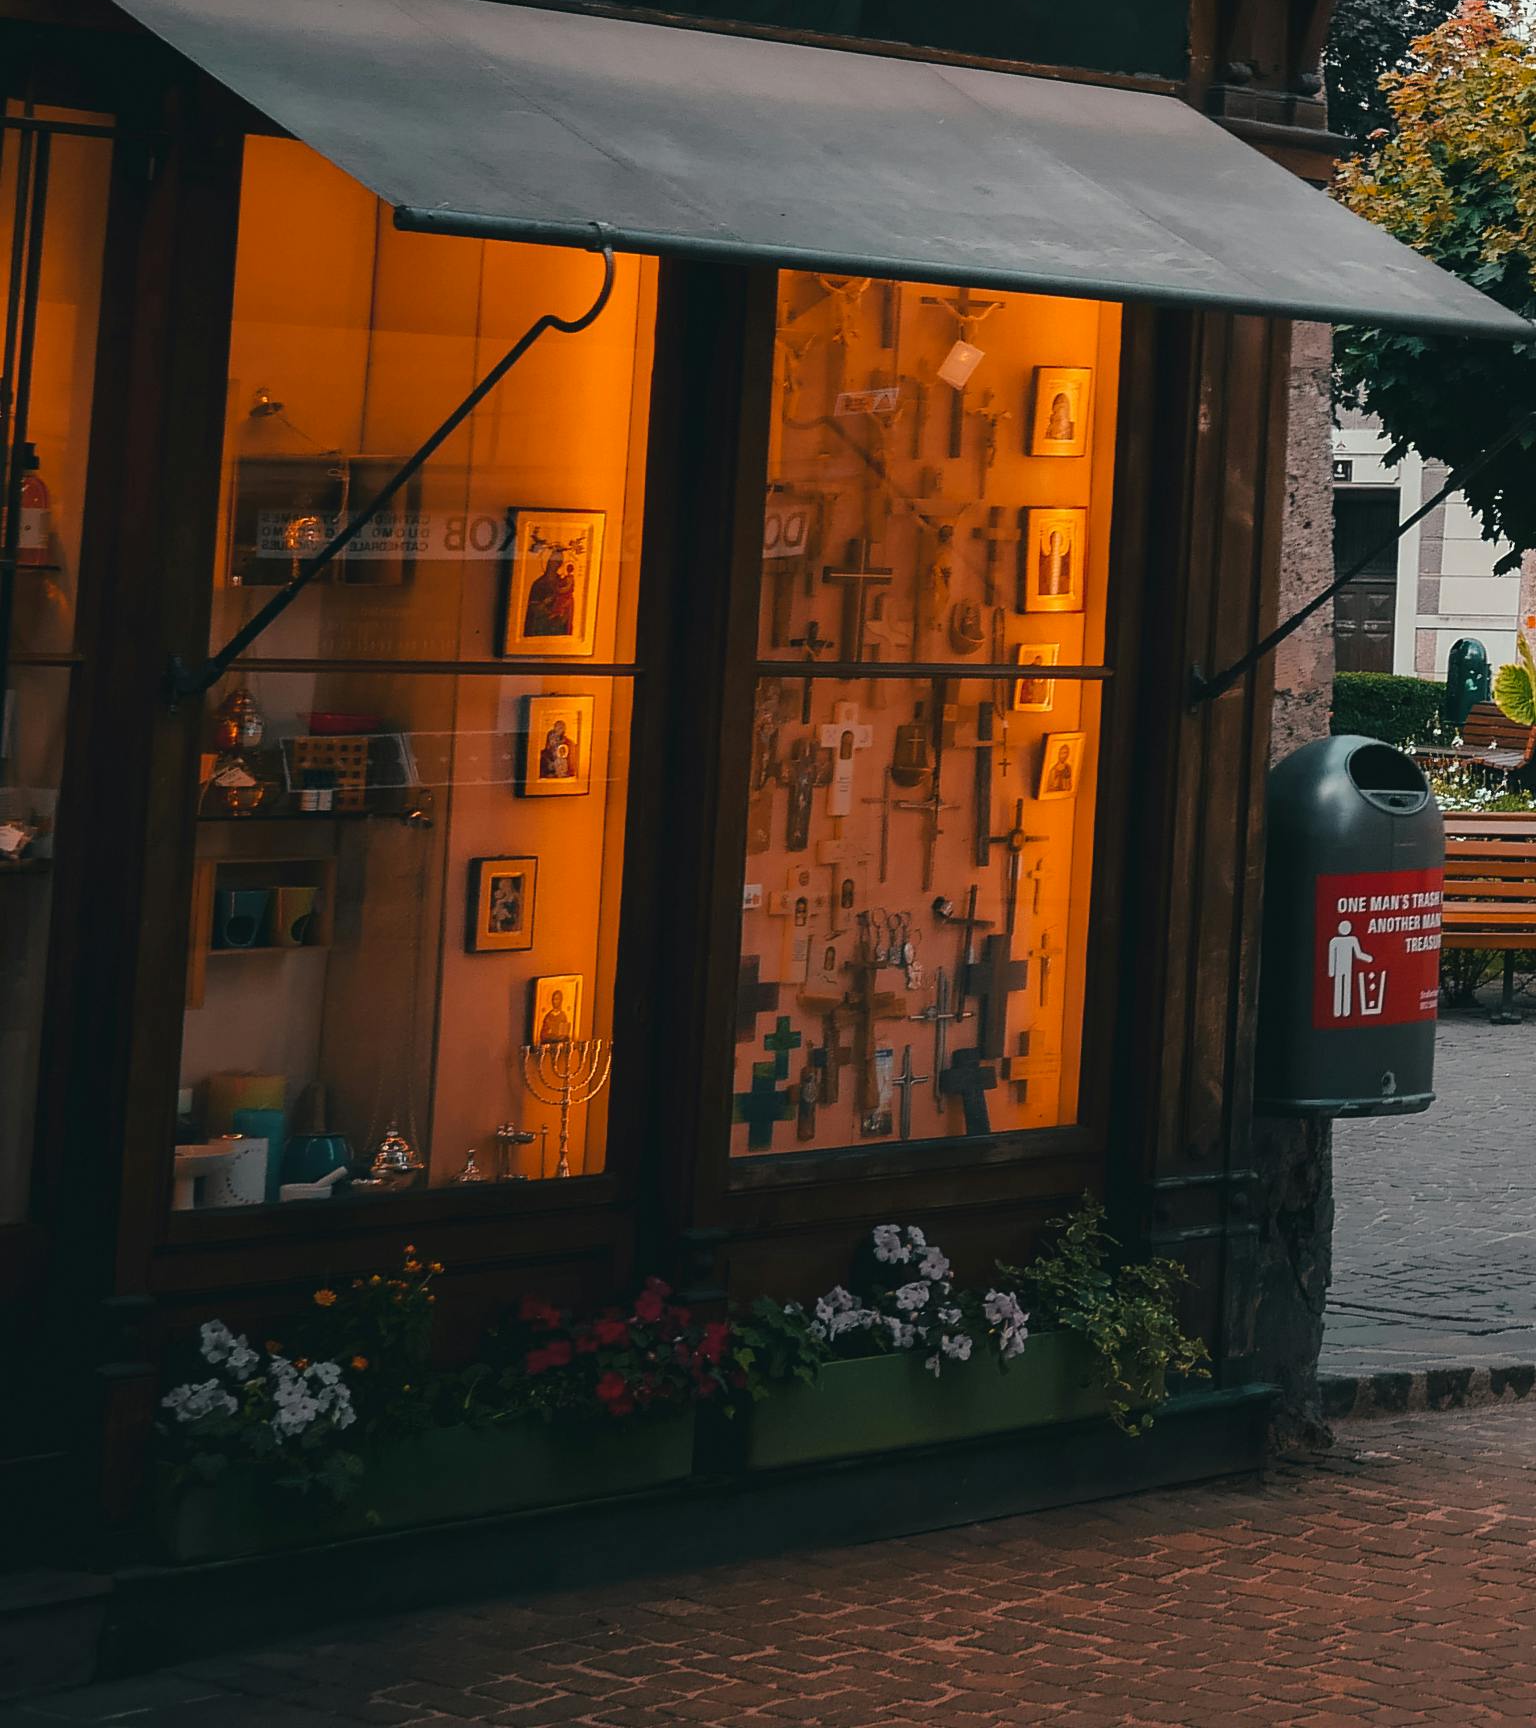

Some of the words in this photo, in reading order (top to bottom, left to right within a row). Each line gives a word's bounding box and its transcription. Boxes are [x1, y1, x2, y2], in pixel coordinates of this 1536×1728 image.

[1337, 896, 1367, 914] ONE
[1370, 894, 1410, 912] MAN'S
[1411, 891, 1440, 908] TRASH
[1368, 915, 1421, 934] ANOTHER
